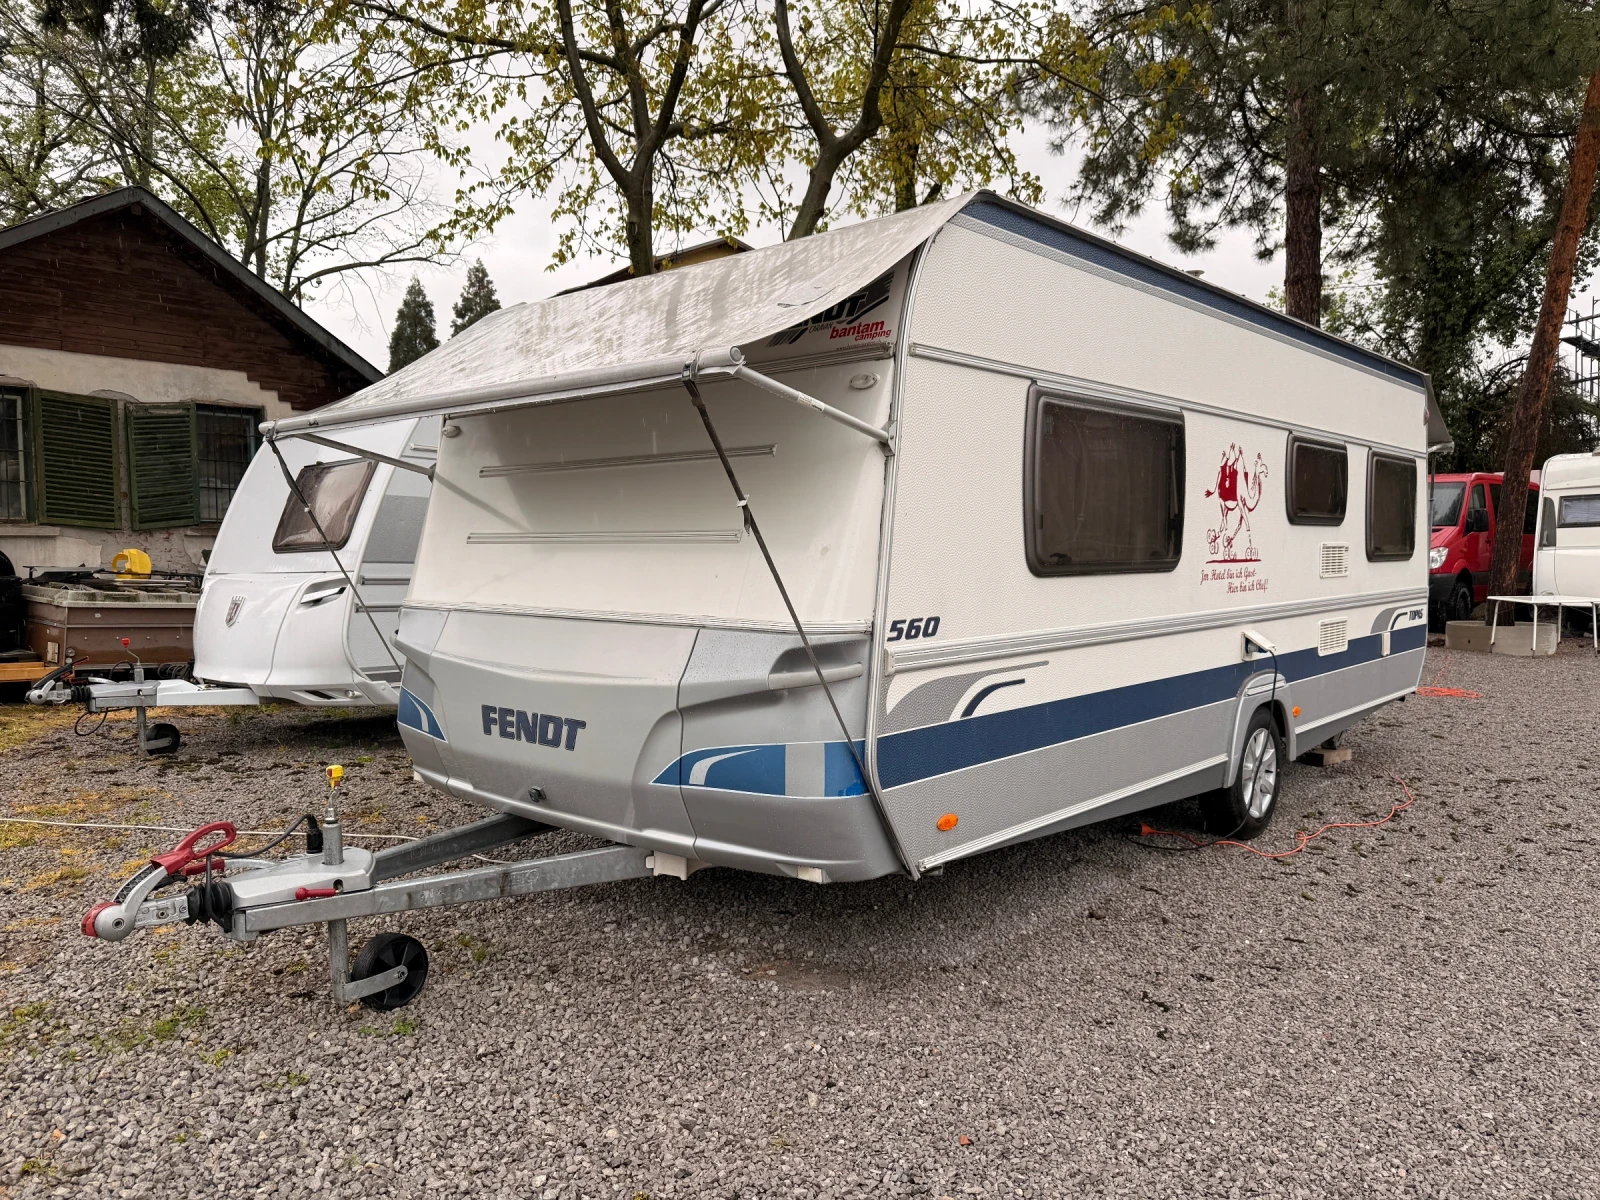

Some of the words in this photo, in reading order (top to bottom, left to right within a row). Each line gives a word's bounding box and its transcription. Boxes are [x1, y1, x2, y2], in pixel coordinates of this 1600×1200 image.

[829, 320, 885, 340] bantam
[854, 329, 892, 342] camping
[1210, 569, 1226, 580] Hotel
[1226, 568, 1235, 580] bin
[1235, 567, 1243, 579] ich
[1226, 582, 1239, 594] Hier
[1239, 581, 1247, 593] bin
[1247, 580, 1255, 592] ich
[1255, 578, 1269, 593] Chef!
[886, 616, 941, 642] 560
[481, 704, 587, 751] FENDT
